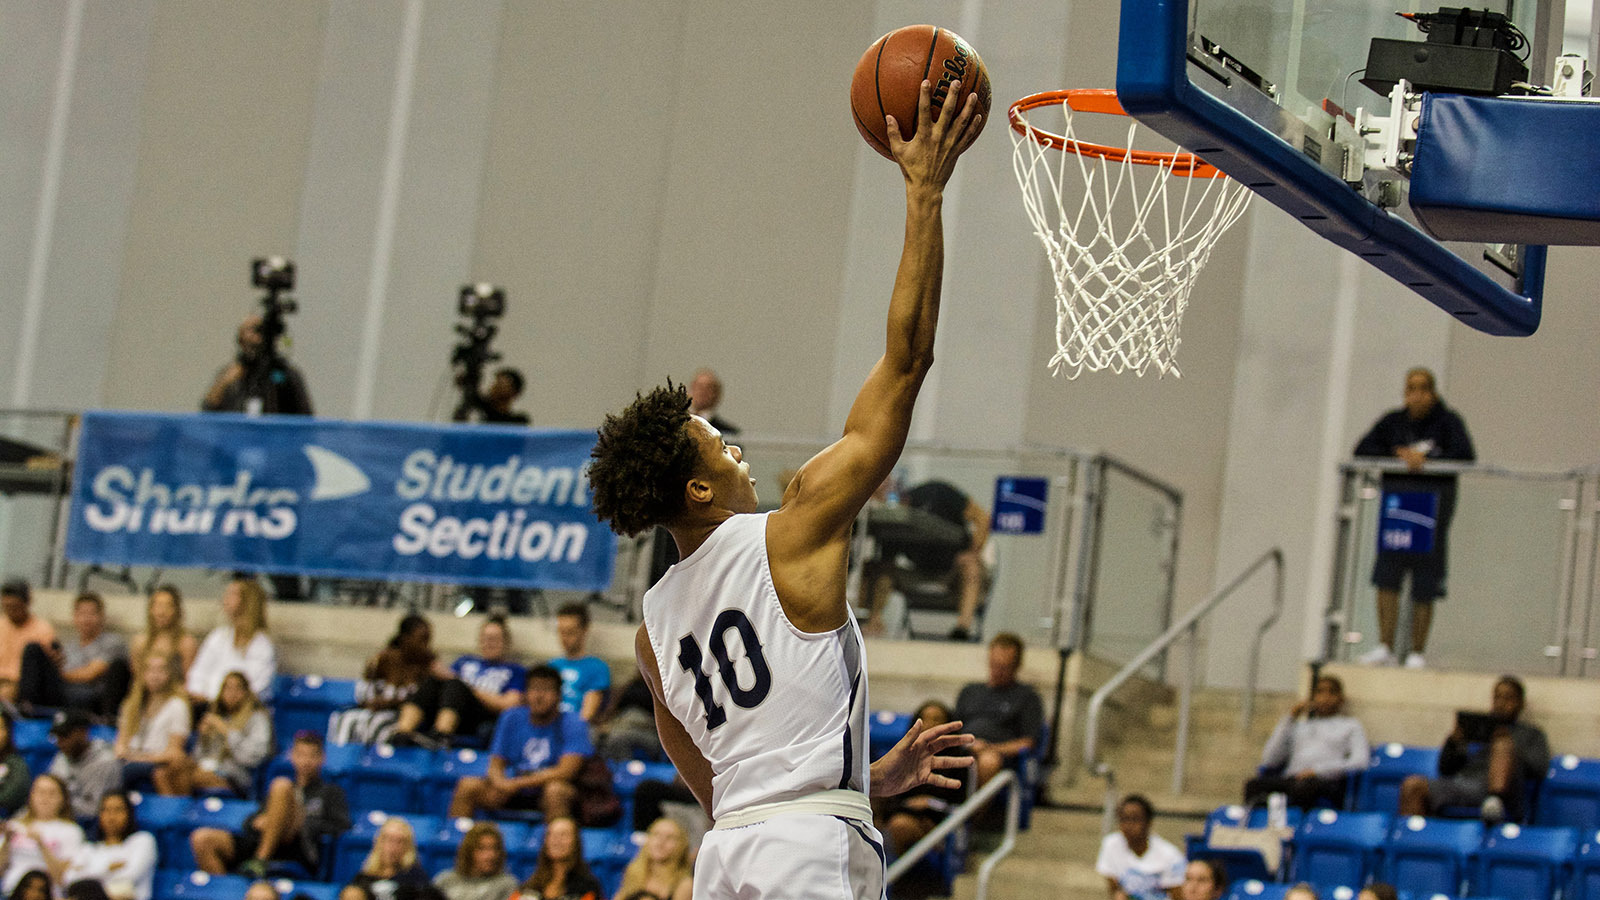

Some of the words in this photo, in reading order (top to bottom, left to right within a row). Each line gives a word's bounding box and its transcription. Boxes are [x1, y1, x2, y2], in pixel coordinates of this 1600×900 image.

[84, 465, 298, 540] Sharks
[396, 449, 591, 507] Student
[392, 502, 588, 563] Section
[678, 606, 773, 733] 10
